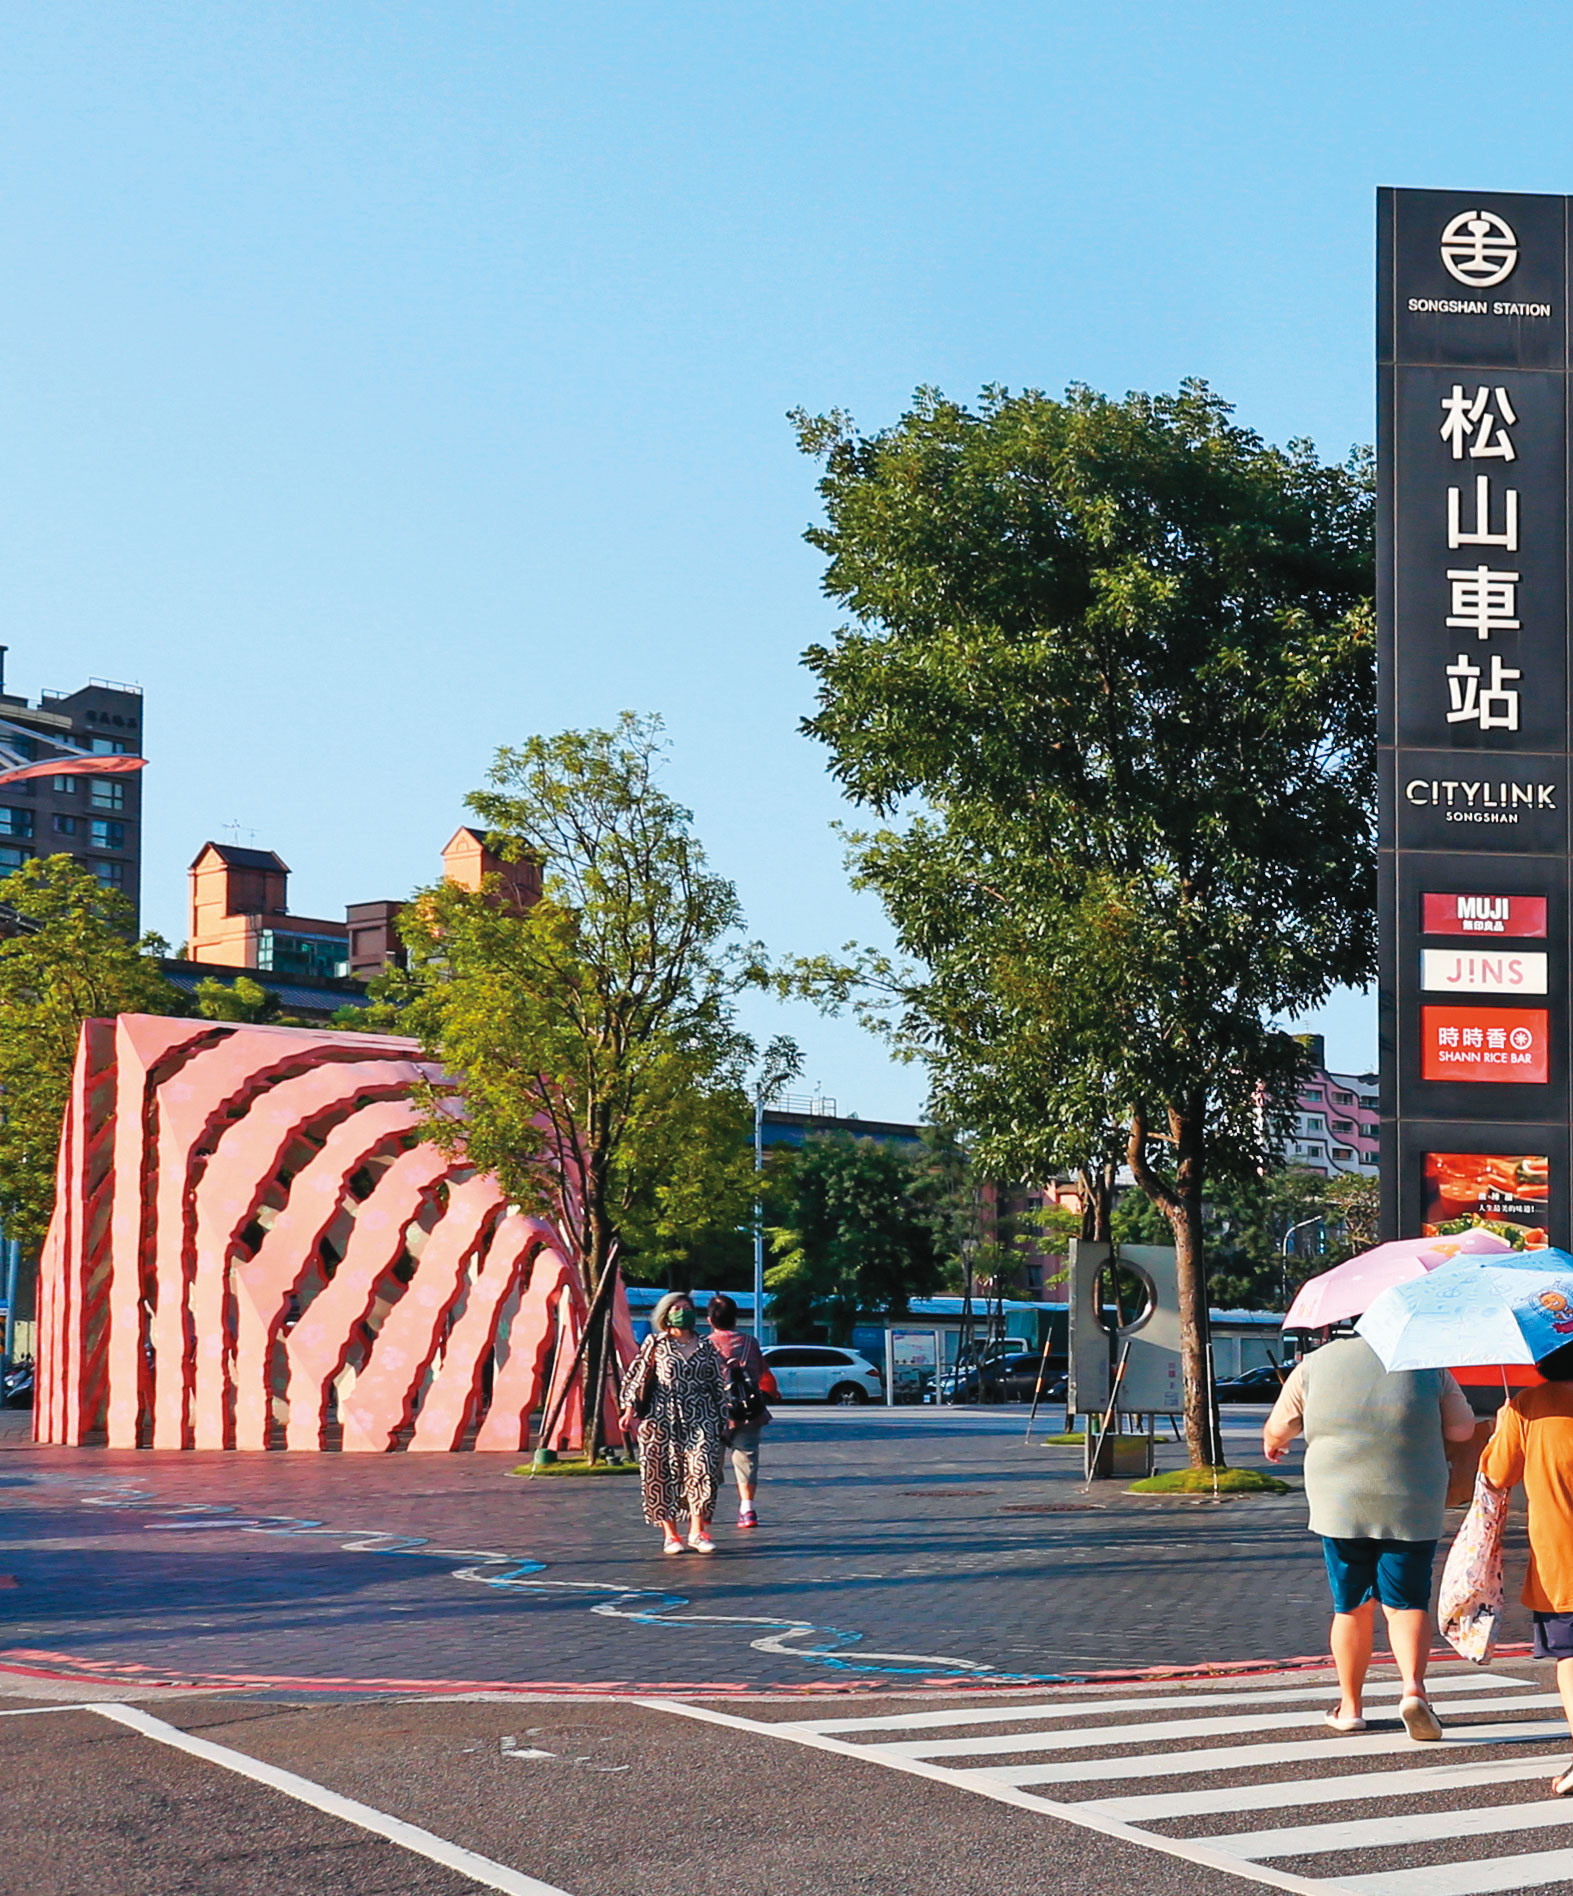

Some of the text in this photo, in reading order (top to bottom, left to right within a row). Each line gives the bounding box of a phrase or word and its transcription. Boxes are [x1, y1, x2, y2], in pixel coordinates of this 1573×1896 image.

[1408, 298, 1551, 316] SONGSHAN STATION
[1440, 385, 1521, 731] 松山車站
[1406, 779, 1557, 809] CITYLINK
[1446, 811, 1518, 823] SONGSHAN
[1457, 897, 1509, 920] MUJI
[1462, 920, 1504, 932] 無印良品
[1438, 1026, 1507, 1049] 時時香
[1438, 1051, 1532, 1064] SHANN RICE BAR
